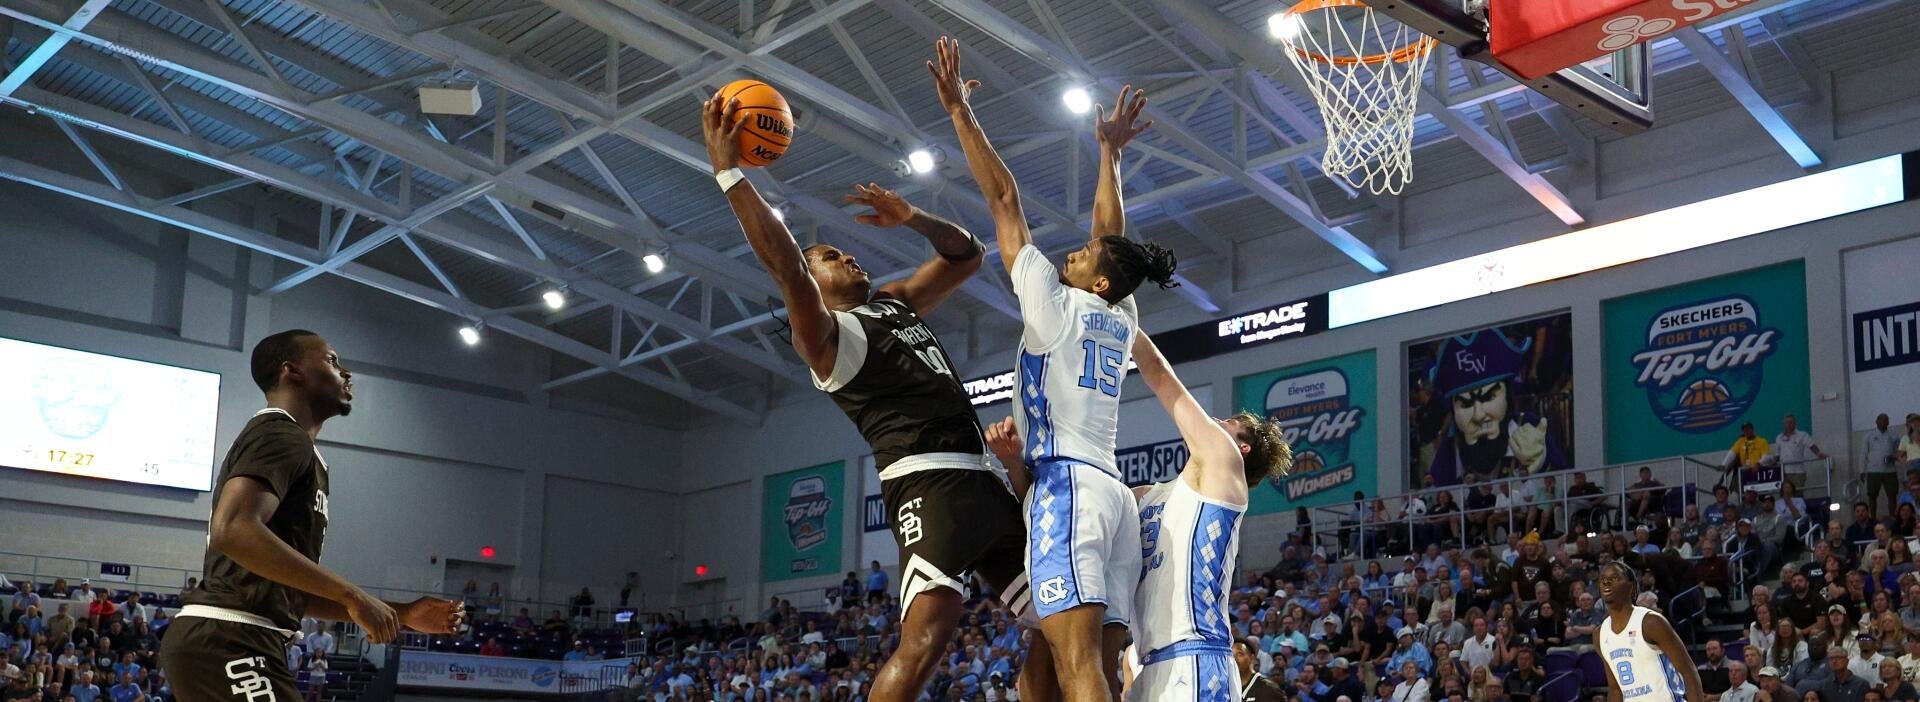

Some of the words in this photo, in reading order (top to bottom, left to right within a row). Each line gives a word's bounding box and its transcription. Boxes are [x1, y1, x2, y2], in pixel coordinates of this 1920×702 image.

[1081, 312, 1132, 345] STEVENSON
[1660, 303, 1744, 329] SKECHERS
[1658, 330, 1691, 347] FORT
[1698, 320, 1747, 339] MYERS
[1078, 339, 1123, 398] 15
[1456, 349, 1486, 374] FSW
[1633, 330, 1775, 386] Tip-Off
[963, 372, 1015, 396] TRADE
[1288, 382, 1325, 396] Elevance
[48, 450, 95, 466] 17:27
[1288, 466, 1352, 499] WOMEN'S
[1757, 469, 1774, 481] 117
[1617, 661, 1634, 685] 8
